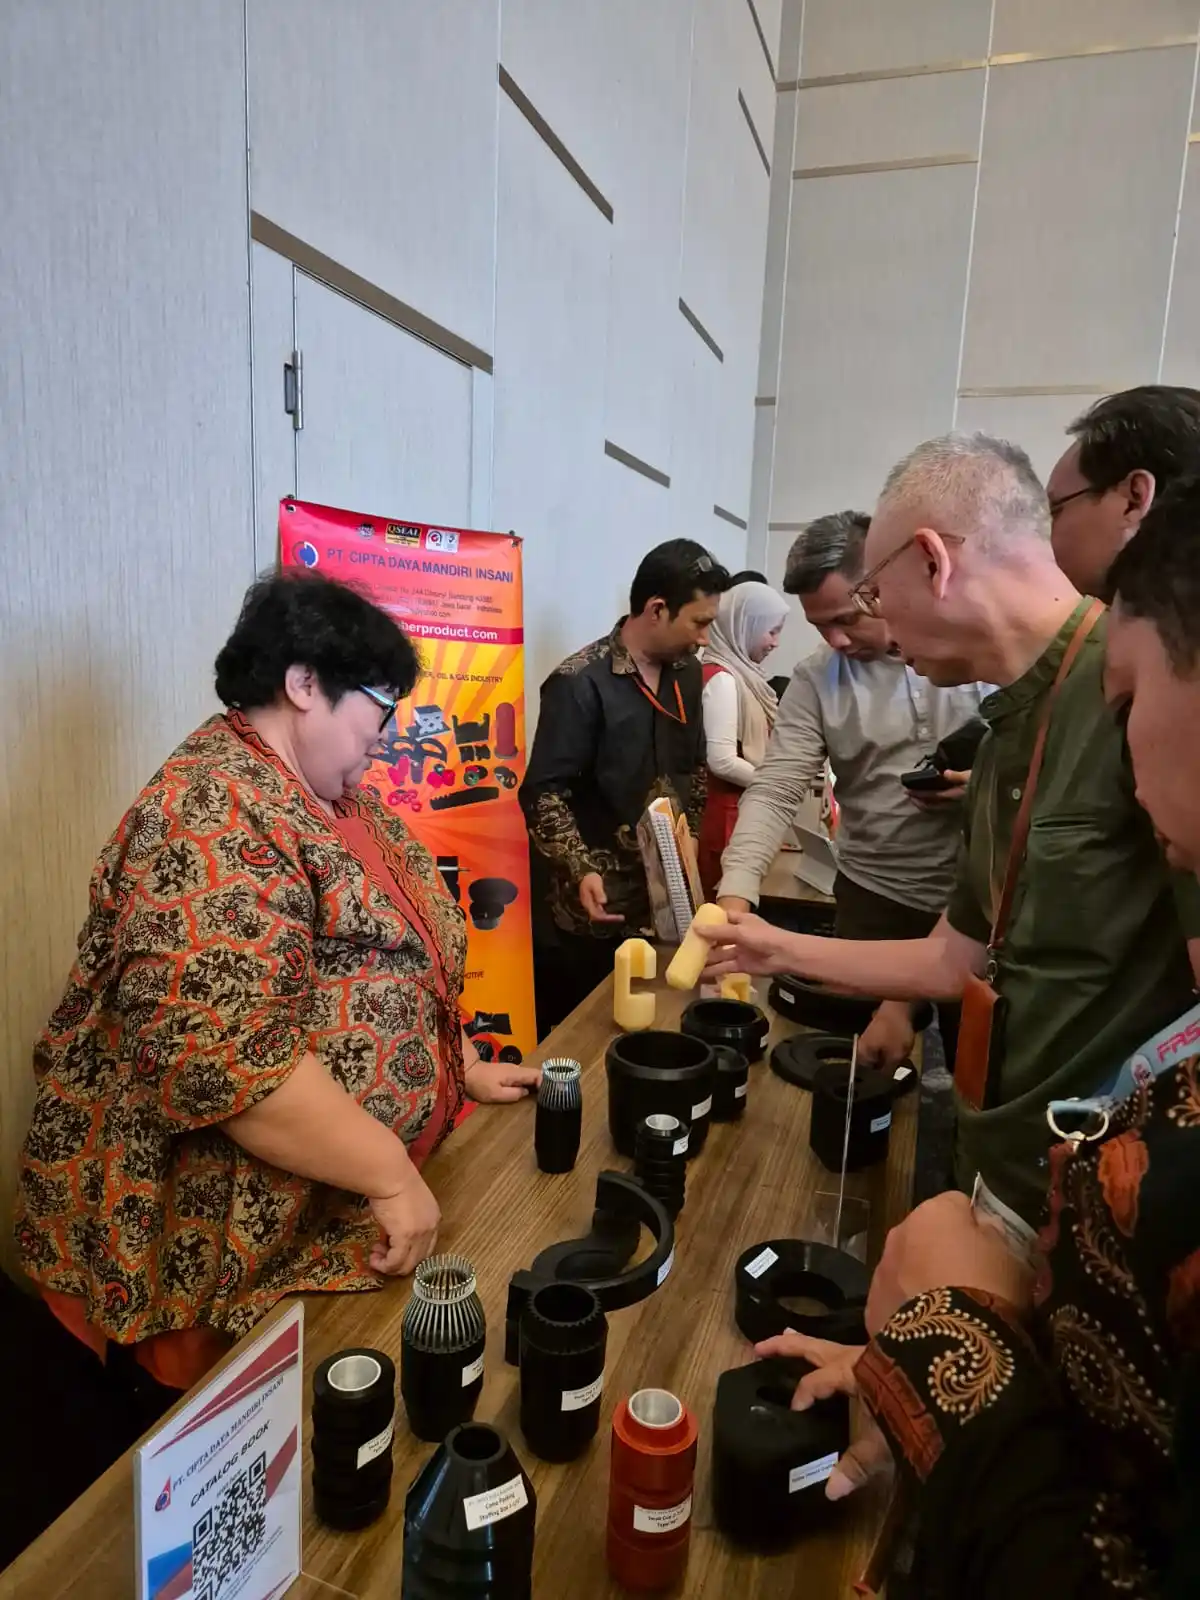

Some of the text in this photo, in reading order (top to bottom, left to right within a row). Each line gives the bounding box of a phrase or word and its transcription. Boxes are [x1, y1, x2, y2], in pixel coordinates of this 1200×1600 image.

[327, 548, 513, 583] PT CIPTA DAYA MANDIRI INSANI
[399, 620, 498, 640] berproduct.com
[470, 674, 503, 683] INDUSTRY
[186, 1451, 208, 1477] CIPTA
[230, 1399, 261, 1433] MANDIRI
[261, 1375, 284, 1402] INSANI
[190, 1419, 271, 1508] CATALOG BOOK
